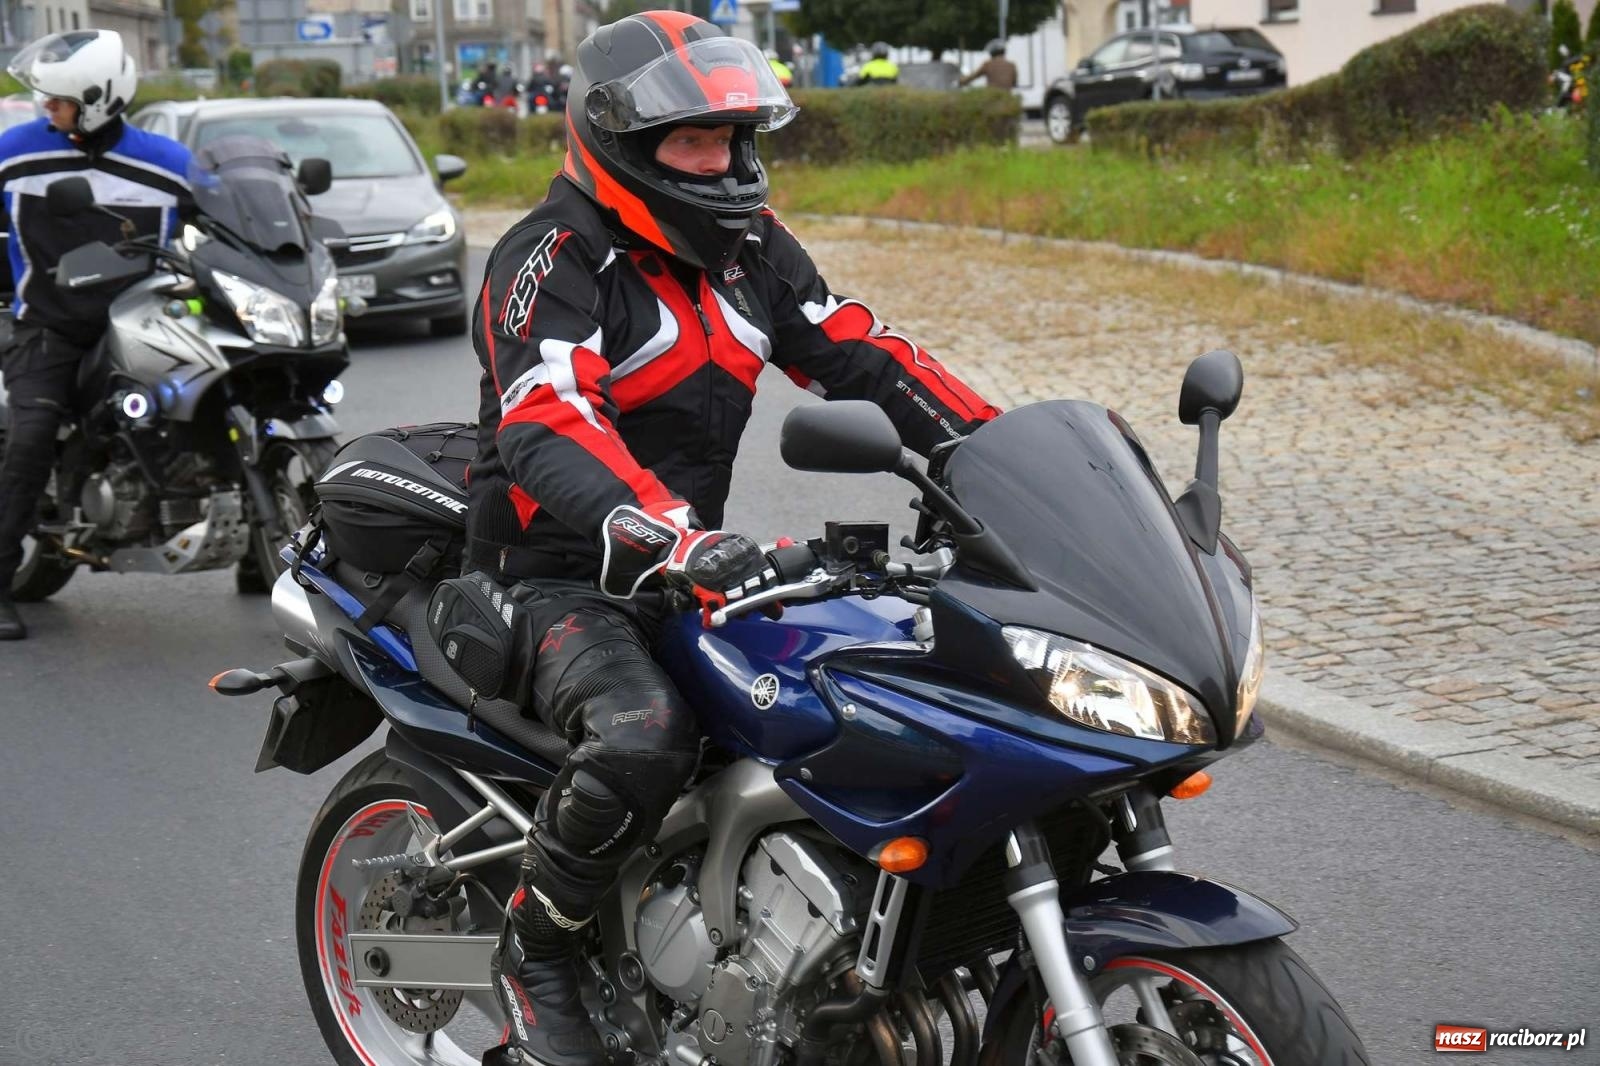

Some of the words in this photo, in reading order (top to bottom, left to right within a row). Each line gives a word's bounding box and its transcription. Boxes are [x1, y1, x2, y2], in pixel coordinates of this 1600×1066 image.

[503, 227, 557, 337] RST
[723, 265, 745, 281] RS
[895, 379, 915, 398] PLUS
[350, 468, 469, 515] MOTOCENTRIC
[612, 516, 672, 544] RST
[611, 708, 654, 726] RST
[328, 883, 364, 1018] FAZER
